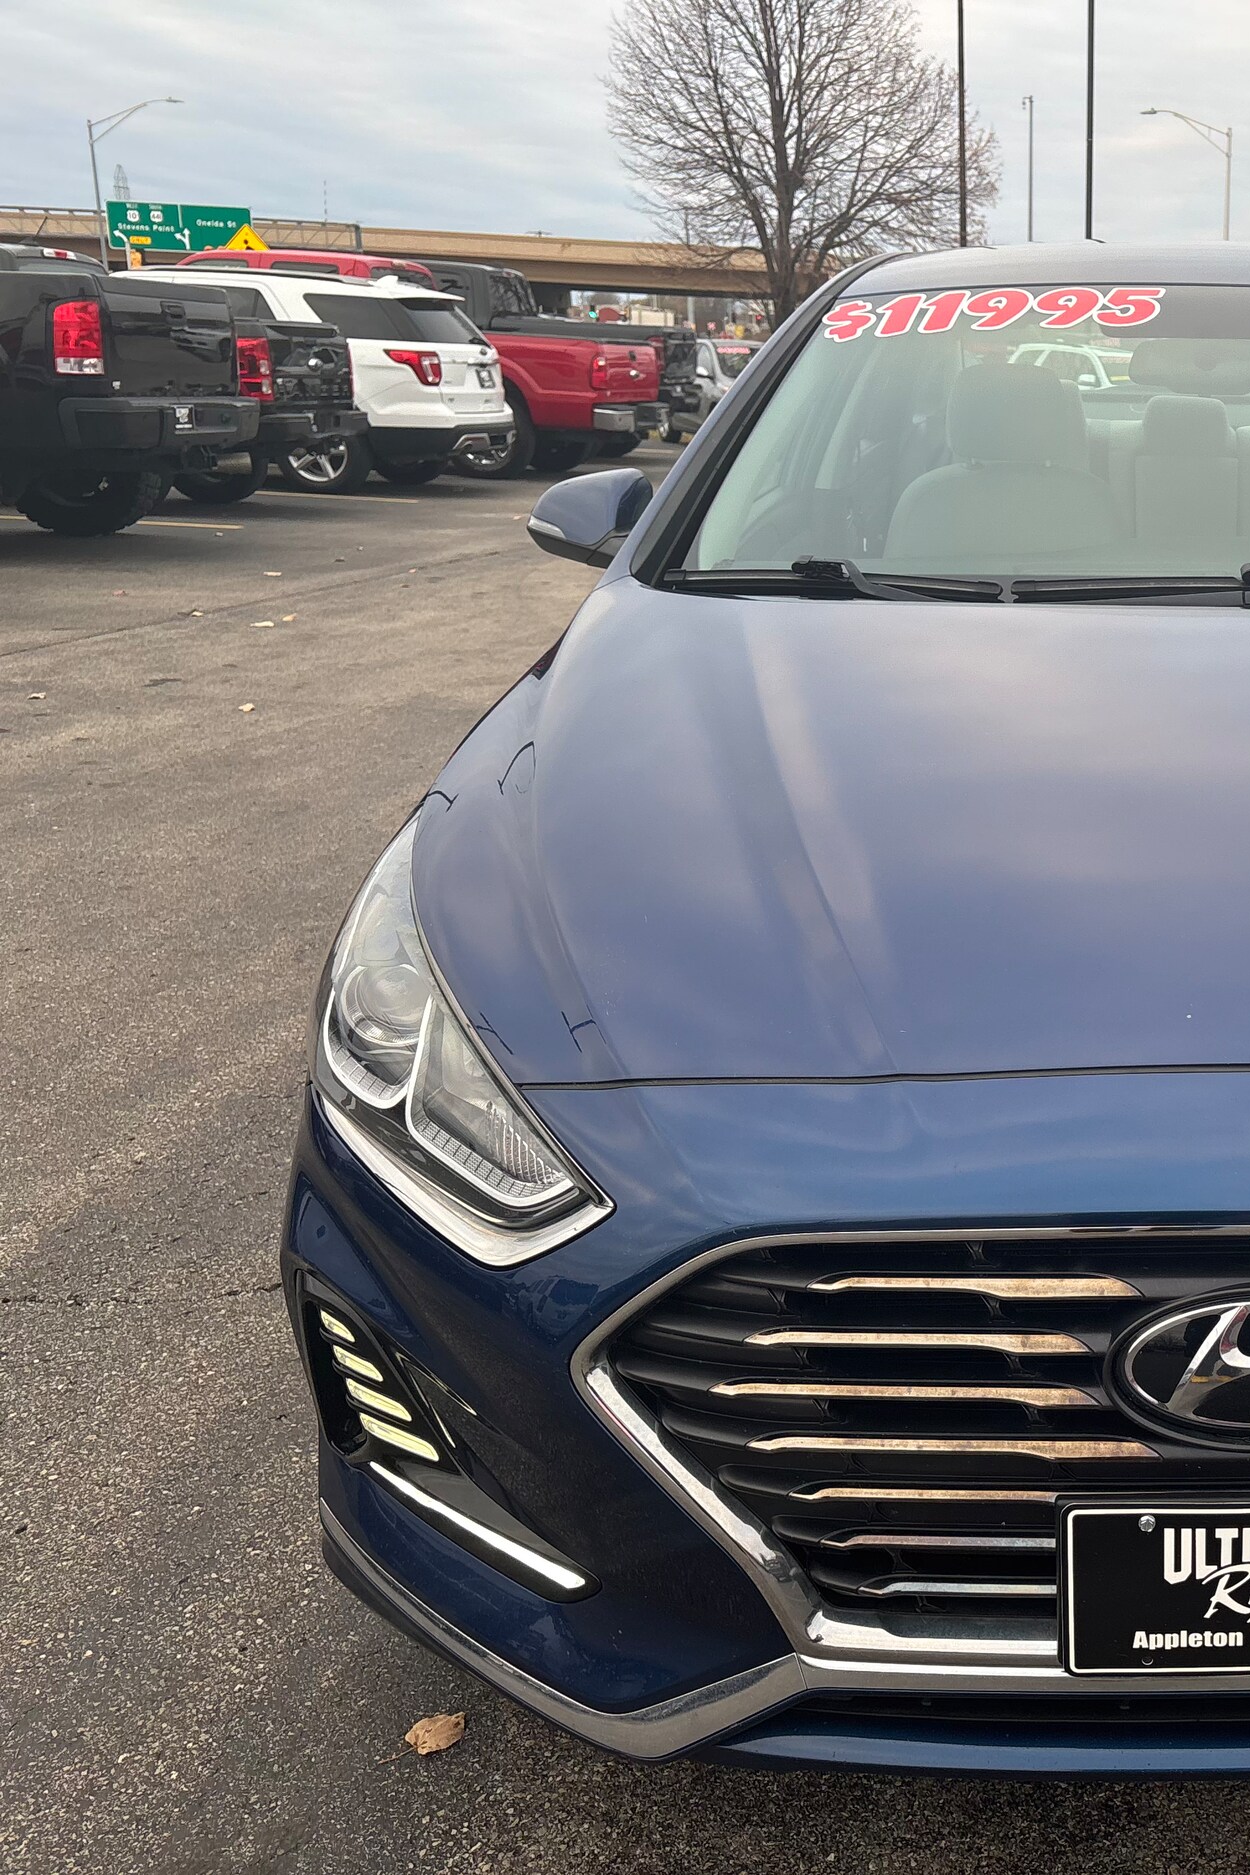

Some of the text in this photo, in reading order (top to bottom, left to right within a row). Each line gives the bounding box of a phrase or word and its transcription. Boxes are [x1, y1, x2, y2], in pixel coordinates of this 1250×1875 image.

[117, 222, 175, 232] Stevens Point
[196, 219, 237, 228] Oneida St
[822, 287, 1166, 343] $11995
[1132, 1630, 1244, 1650] Appleton
